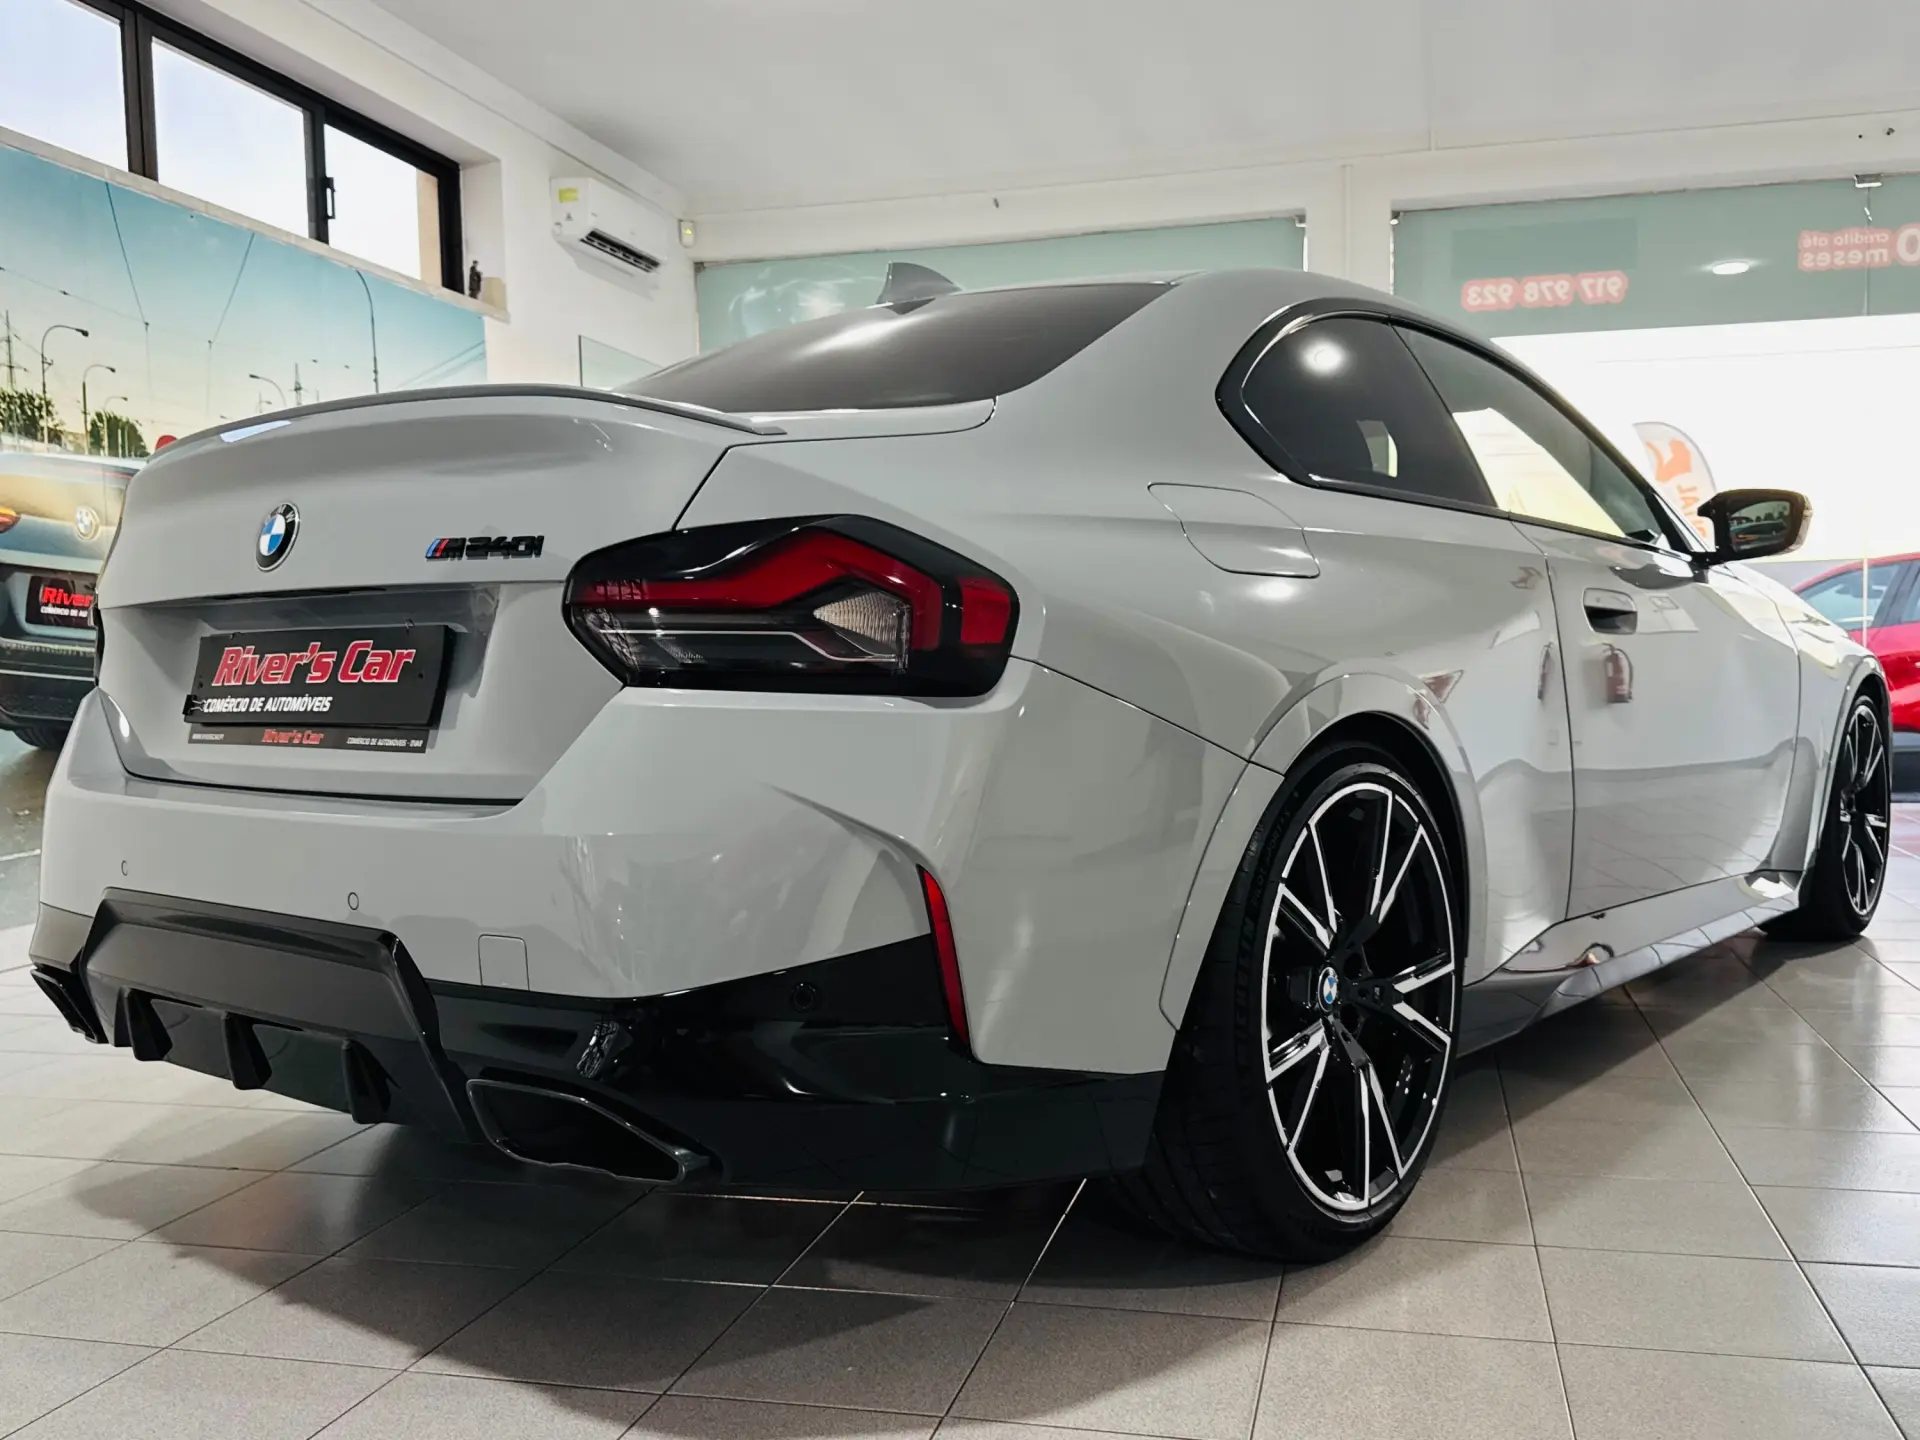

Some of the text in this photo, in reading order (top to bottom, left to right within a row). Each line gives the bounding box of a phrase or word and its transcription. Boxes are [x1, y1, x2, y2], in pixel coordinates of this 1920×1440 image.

[212, 640, 416, 685] River's Car
[203, 693, 334, 713] COMÉRCIO DE AUTOMÓVEIS
[302, 730, 325, 744] Car
